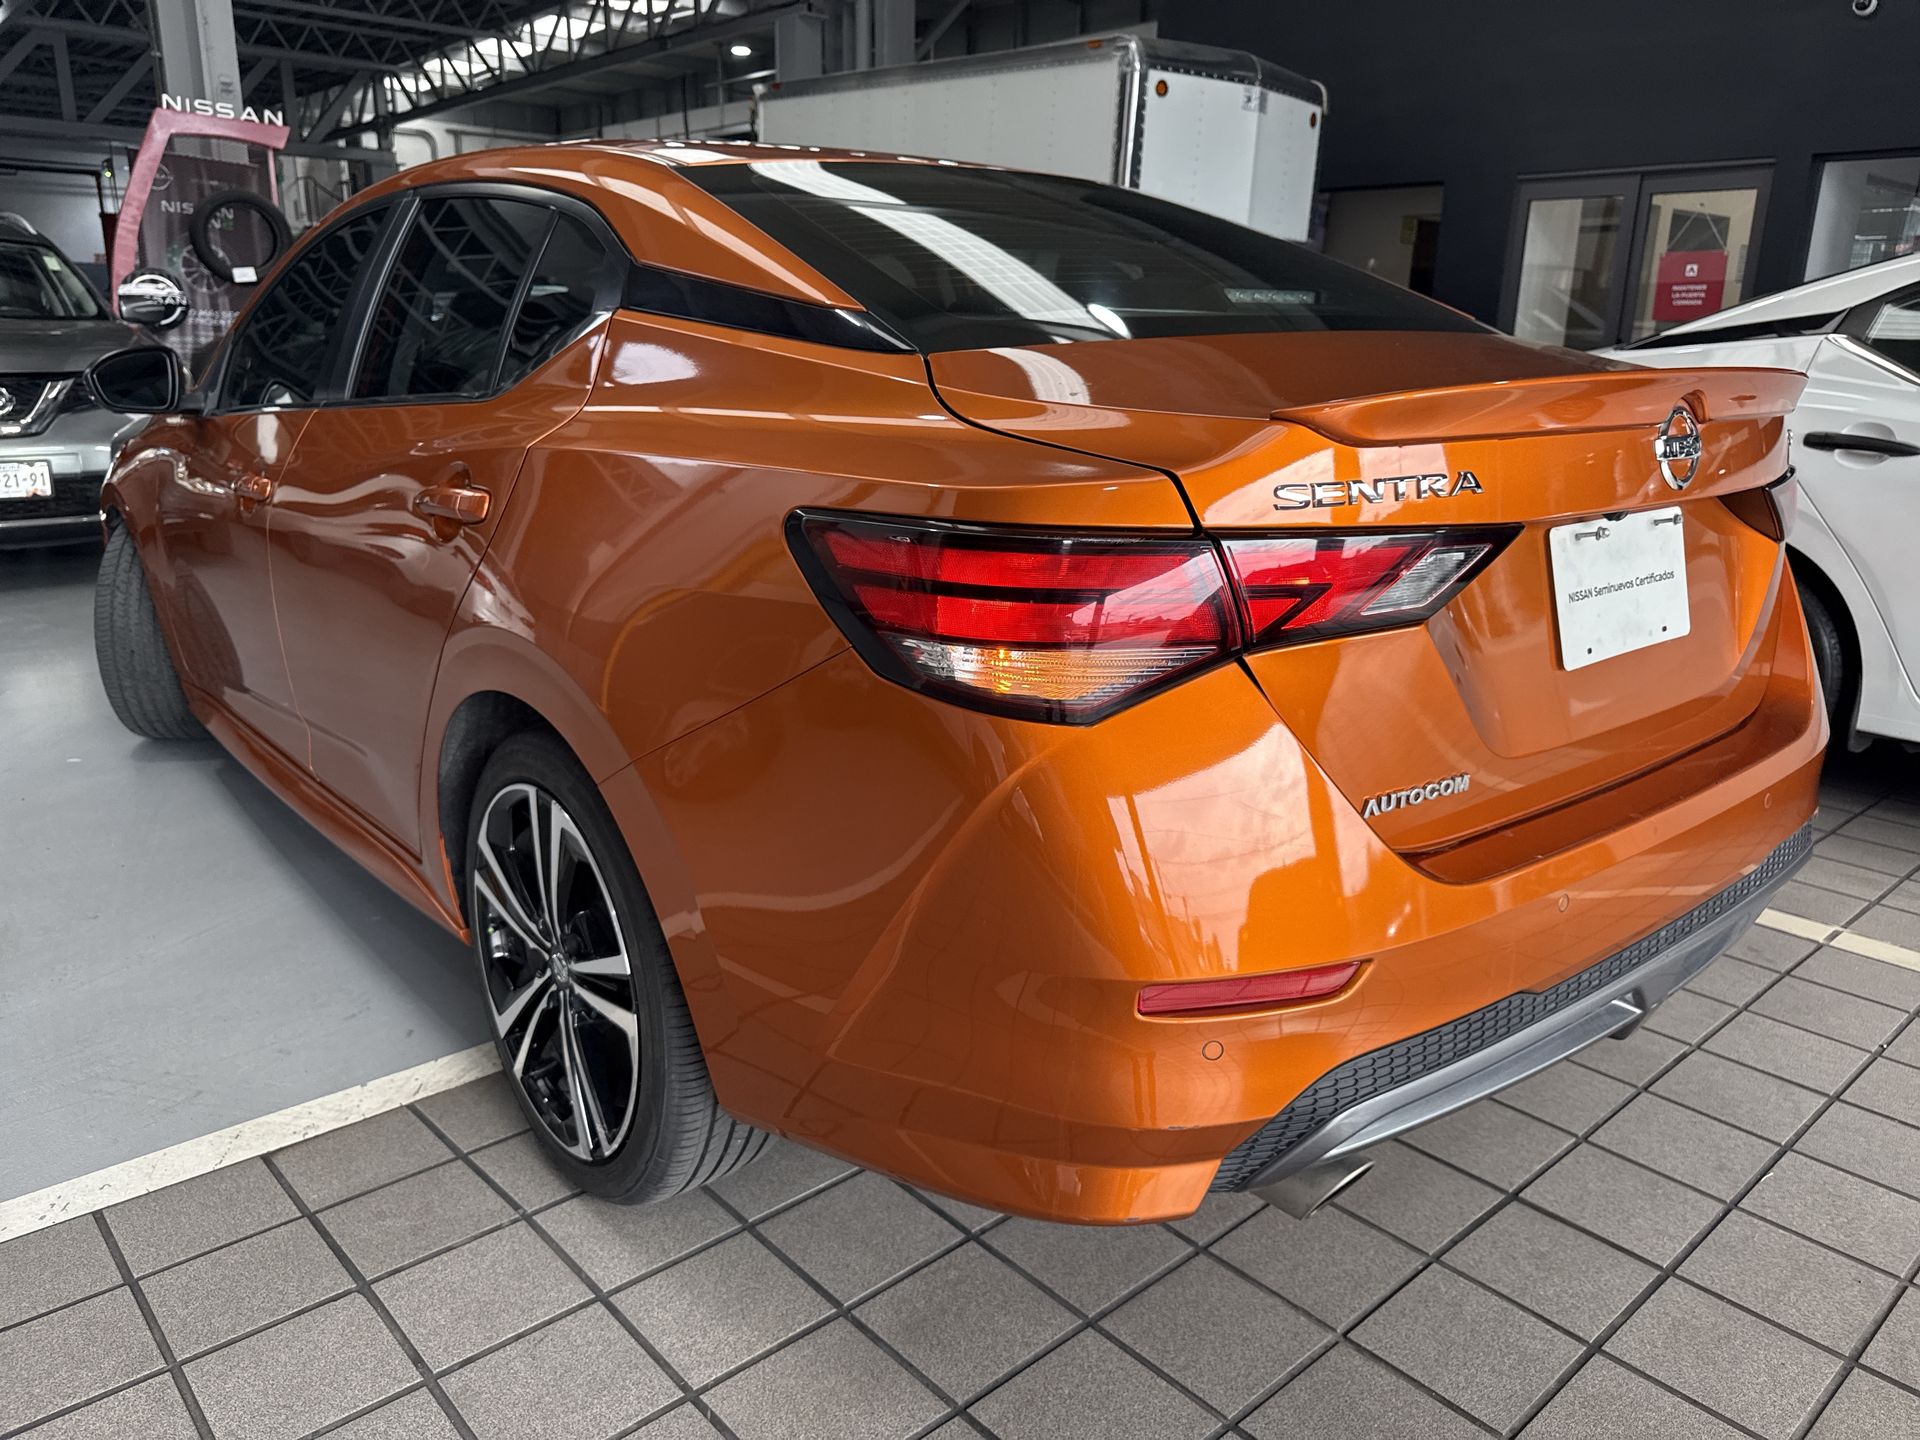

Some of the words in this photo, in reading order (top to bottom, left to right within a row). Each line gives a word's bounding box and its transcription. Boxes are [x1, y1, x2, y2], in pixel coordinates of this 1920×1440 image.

[161, 93, 284, 127] NISSAN
[1272, 470, 1485, 511] SENTRA
[1568, 587, 1593, 604] NISSAN
[1594, 578, 1634, 598] Seminuevos
[1634, 569, 1675, 588] Certificados
[1361, 772, 1471, 820] AUTOCOM
